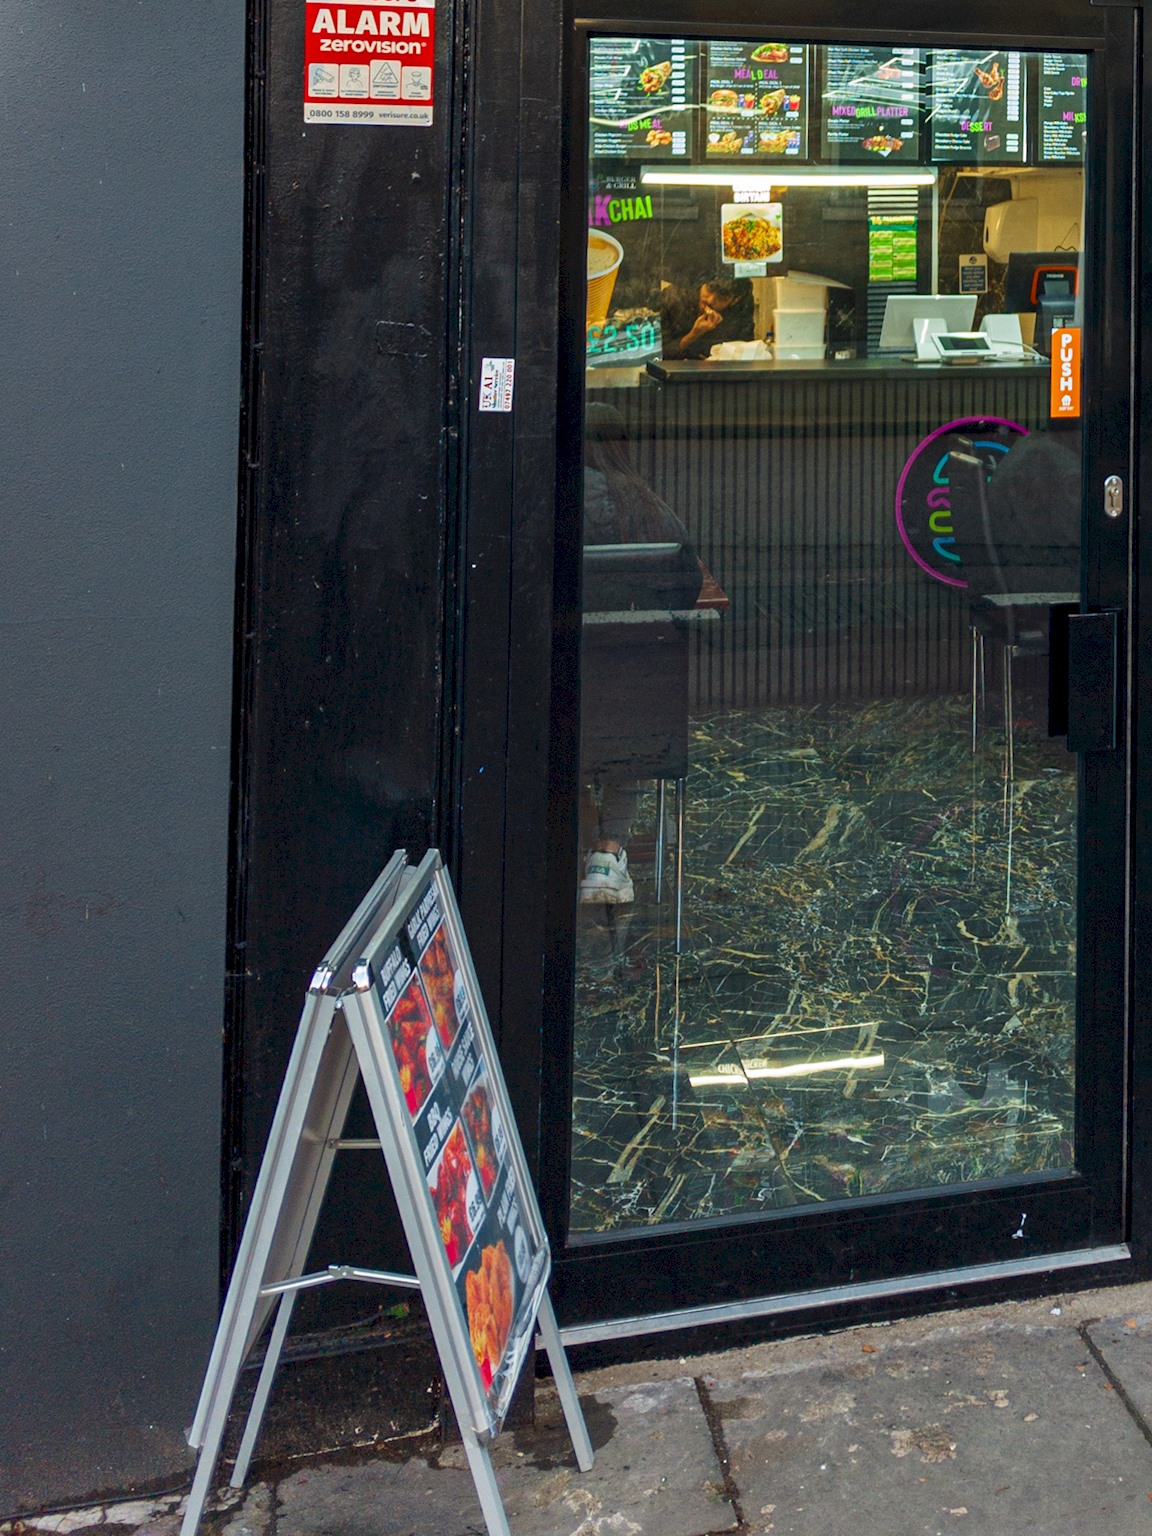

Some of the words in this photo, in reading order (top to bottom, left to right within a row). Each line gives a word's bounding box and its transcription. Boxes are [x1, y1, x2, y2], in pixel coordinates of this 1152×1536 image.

[312, 8, 430, 37] ALARM
[734, 68, 756, 81] MEAL
[757, 68, 778, 81] DEAL
[310, 109, 333, 117] 0800
[335, 110, 350, 118] 158
[352, 110, 375, 118] 8999
[378, 110, 429, 119] verisure.co.uk
[832, 106, 856, 117] MIXED
[856, 107, 877, 118] GRILL
[876, 106, 909, 117] PLATTER
[961, 121, 993, 132] DESSERT
[608, 195, 653, 223] CHAI
[586, 323, 656, 353] £2.50
[1059, 333, 1073, 391] PUSH
[426, 1097, 441, 1137] BBQ
